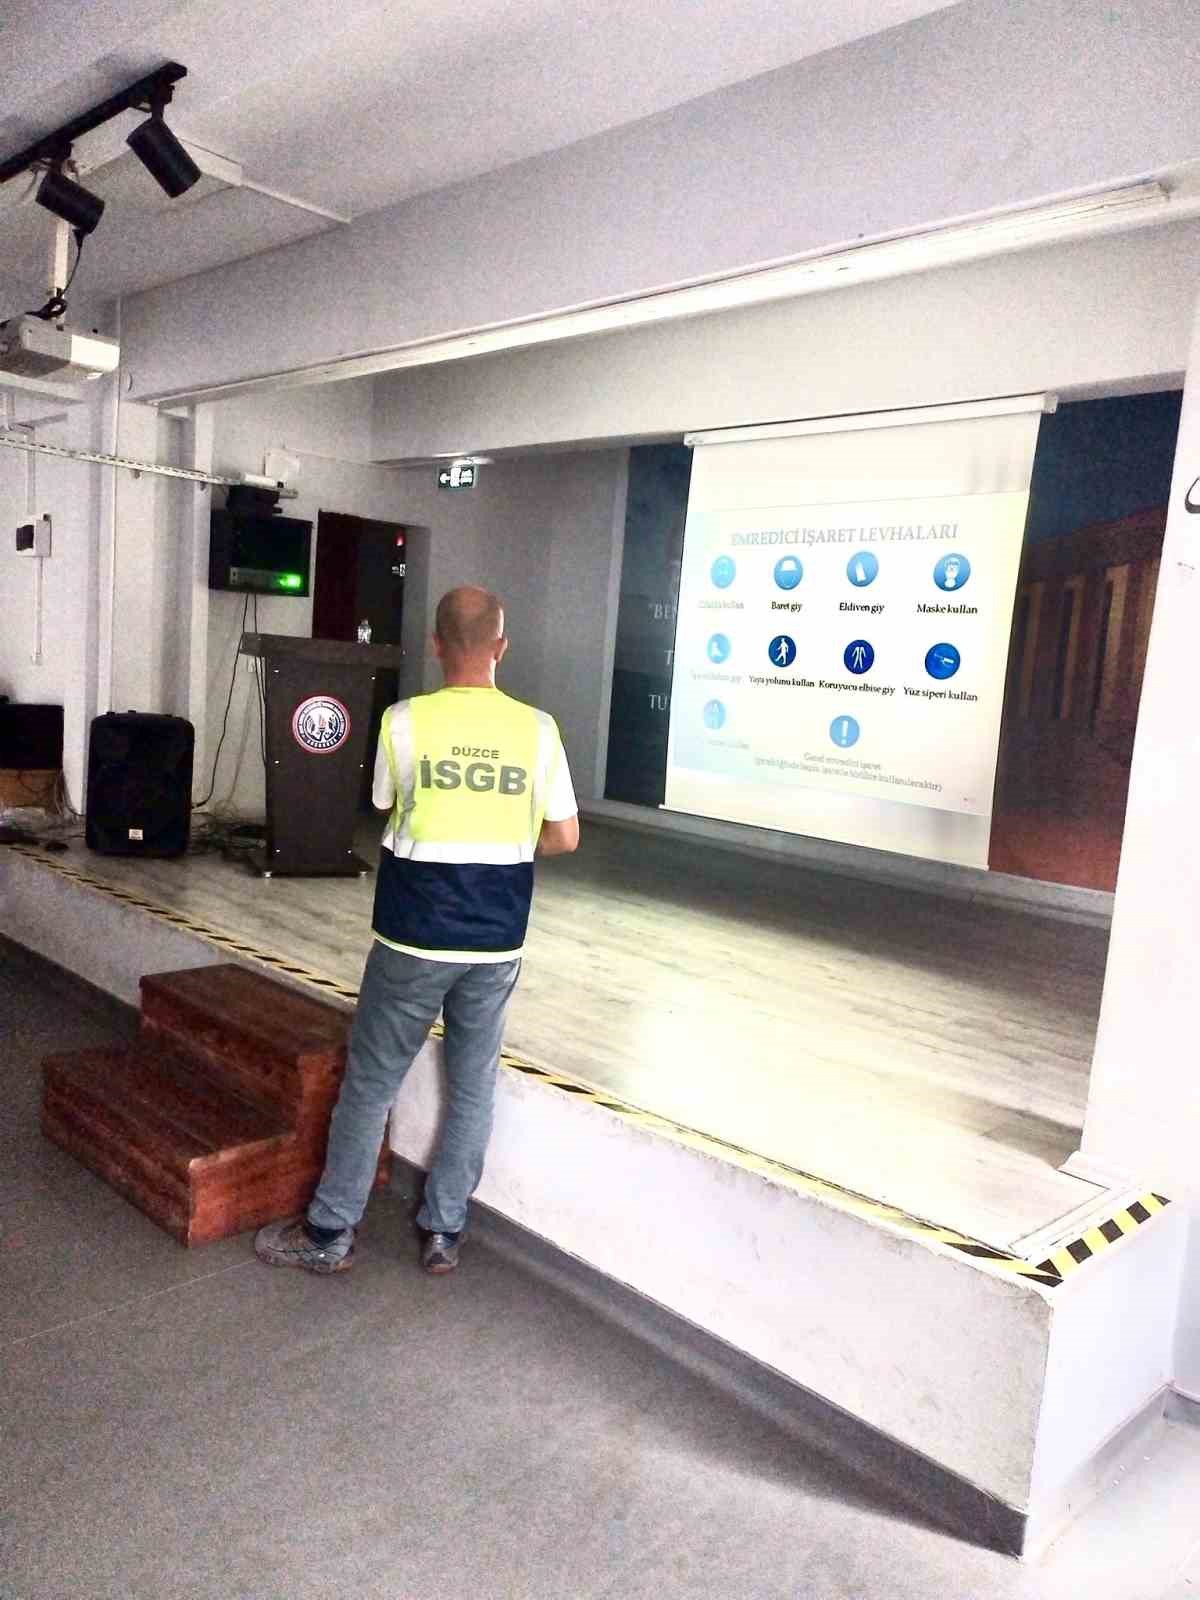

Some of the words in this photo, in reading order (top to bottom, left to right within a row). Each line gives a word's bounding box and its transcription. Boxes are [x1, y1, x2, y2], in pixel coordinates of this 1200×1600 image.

[731, 529, 800, 546] EMREDİCİ
[801, 527, 856, 547] İŞARET
[859, 524, 959, 542] LEVHALARI
[771, 600, 791, 611] Baret
[792, 602, 803, 613] giy
[839, 602, 870, 613] Eldiven
[871, 605, 885, 615] giy
[917, 604, 946, 614] Maske
[947, 604, 978, 615] kullan
[766, 677, 791, 687] yolunu
[792, 678, 815, 687] kullan
[818, 680, 858, 691] Koruyucu
[859, 684, 881, 693] elbise
[881, 687, 896, 696] giy
[922, 689, 947, 700] siperi
[948, 691, 978, 702] kullan
[420, 754, 528, 795] İSGB
